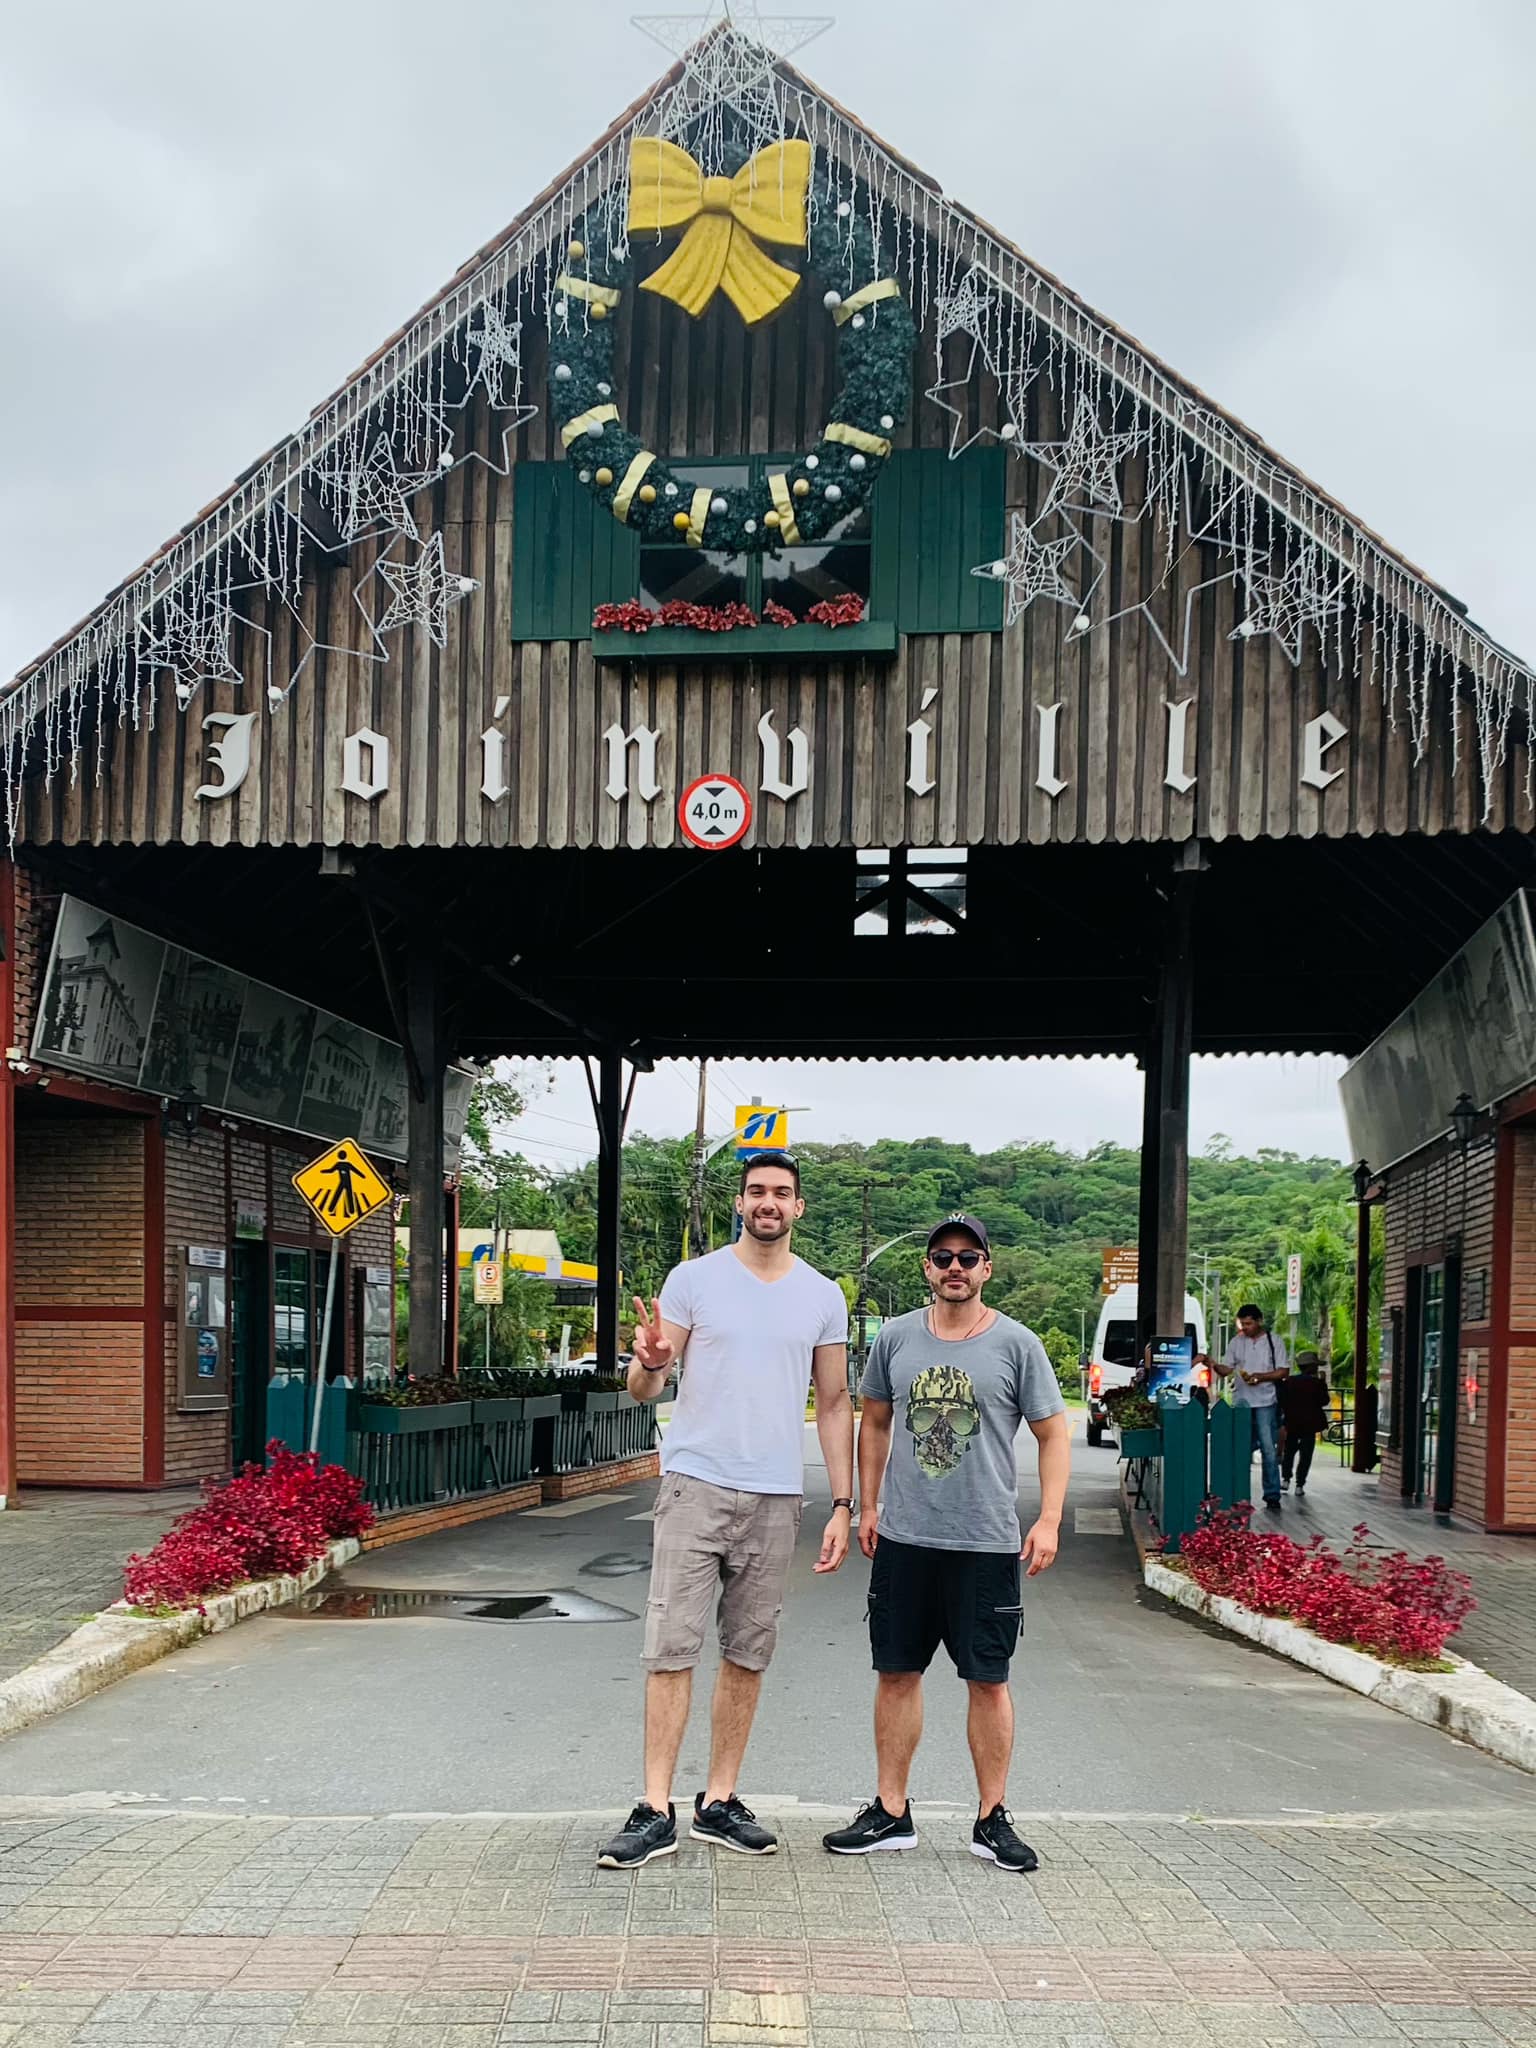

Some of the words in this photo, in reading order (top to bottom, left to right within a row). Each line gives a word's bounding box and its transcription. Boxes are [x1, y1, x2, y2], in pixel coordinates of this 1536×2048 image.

[692, 802, 720, 821] 4,0
[724, 808, 738, 819] m
[485, 1267, 493, 1280] E
